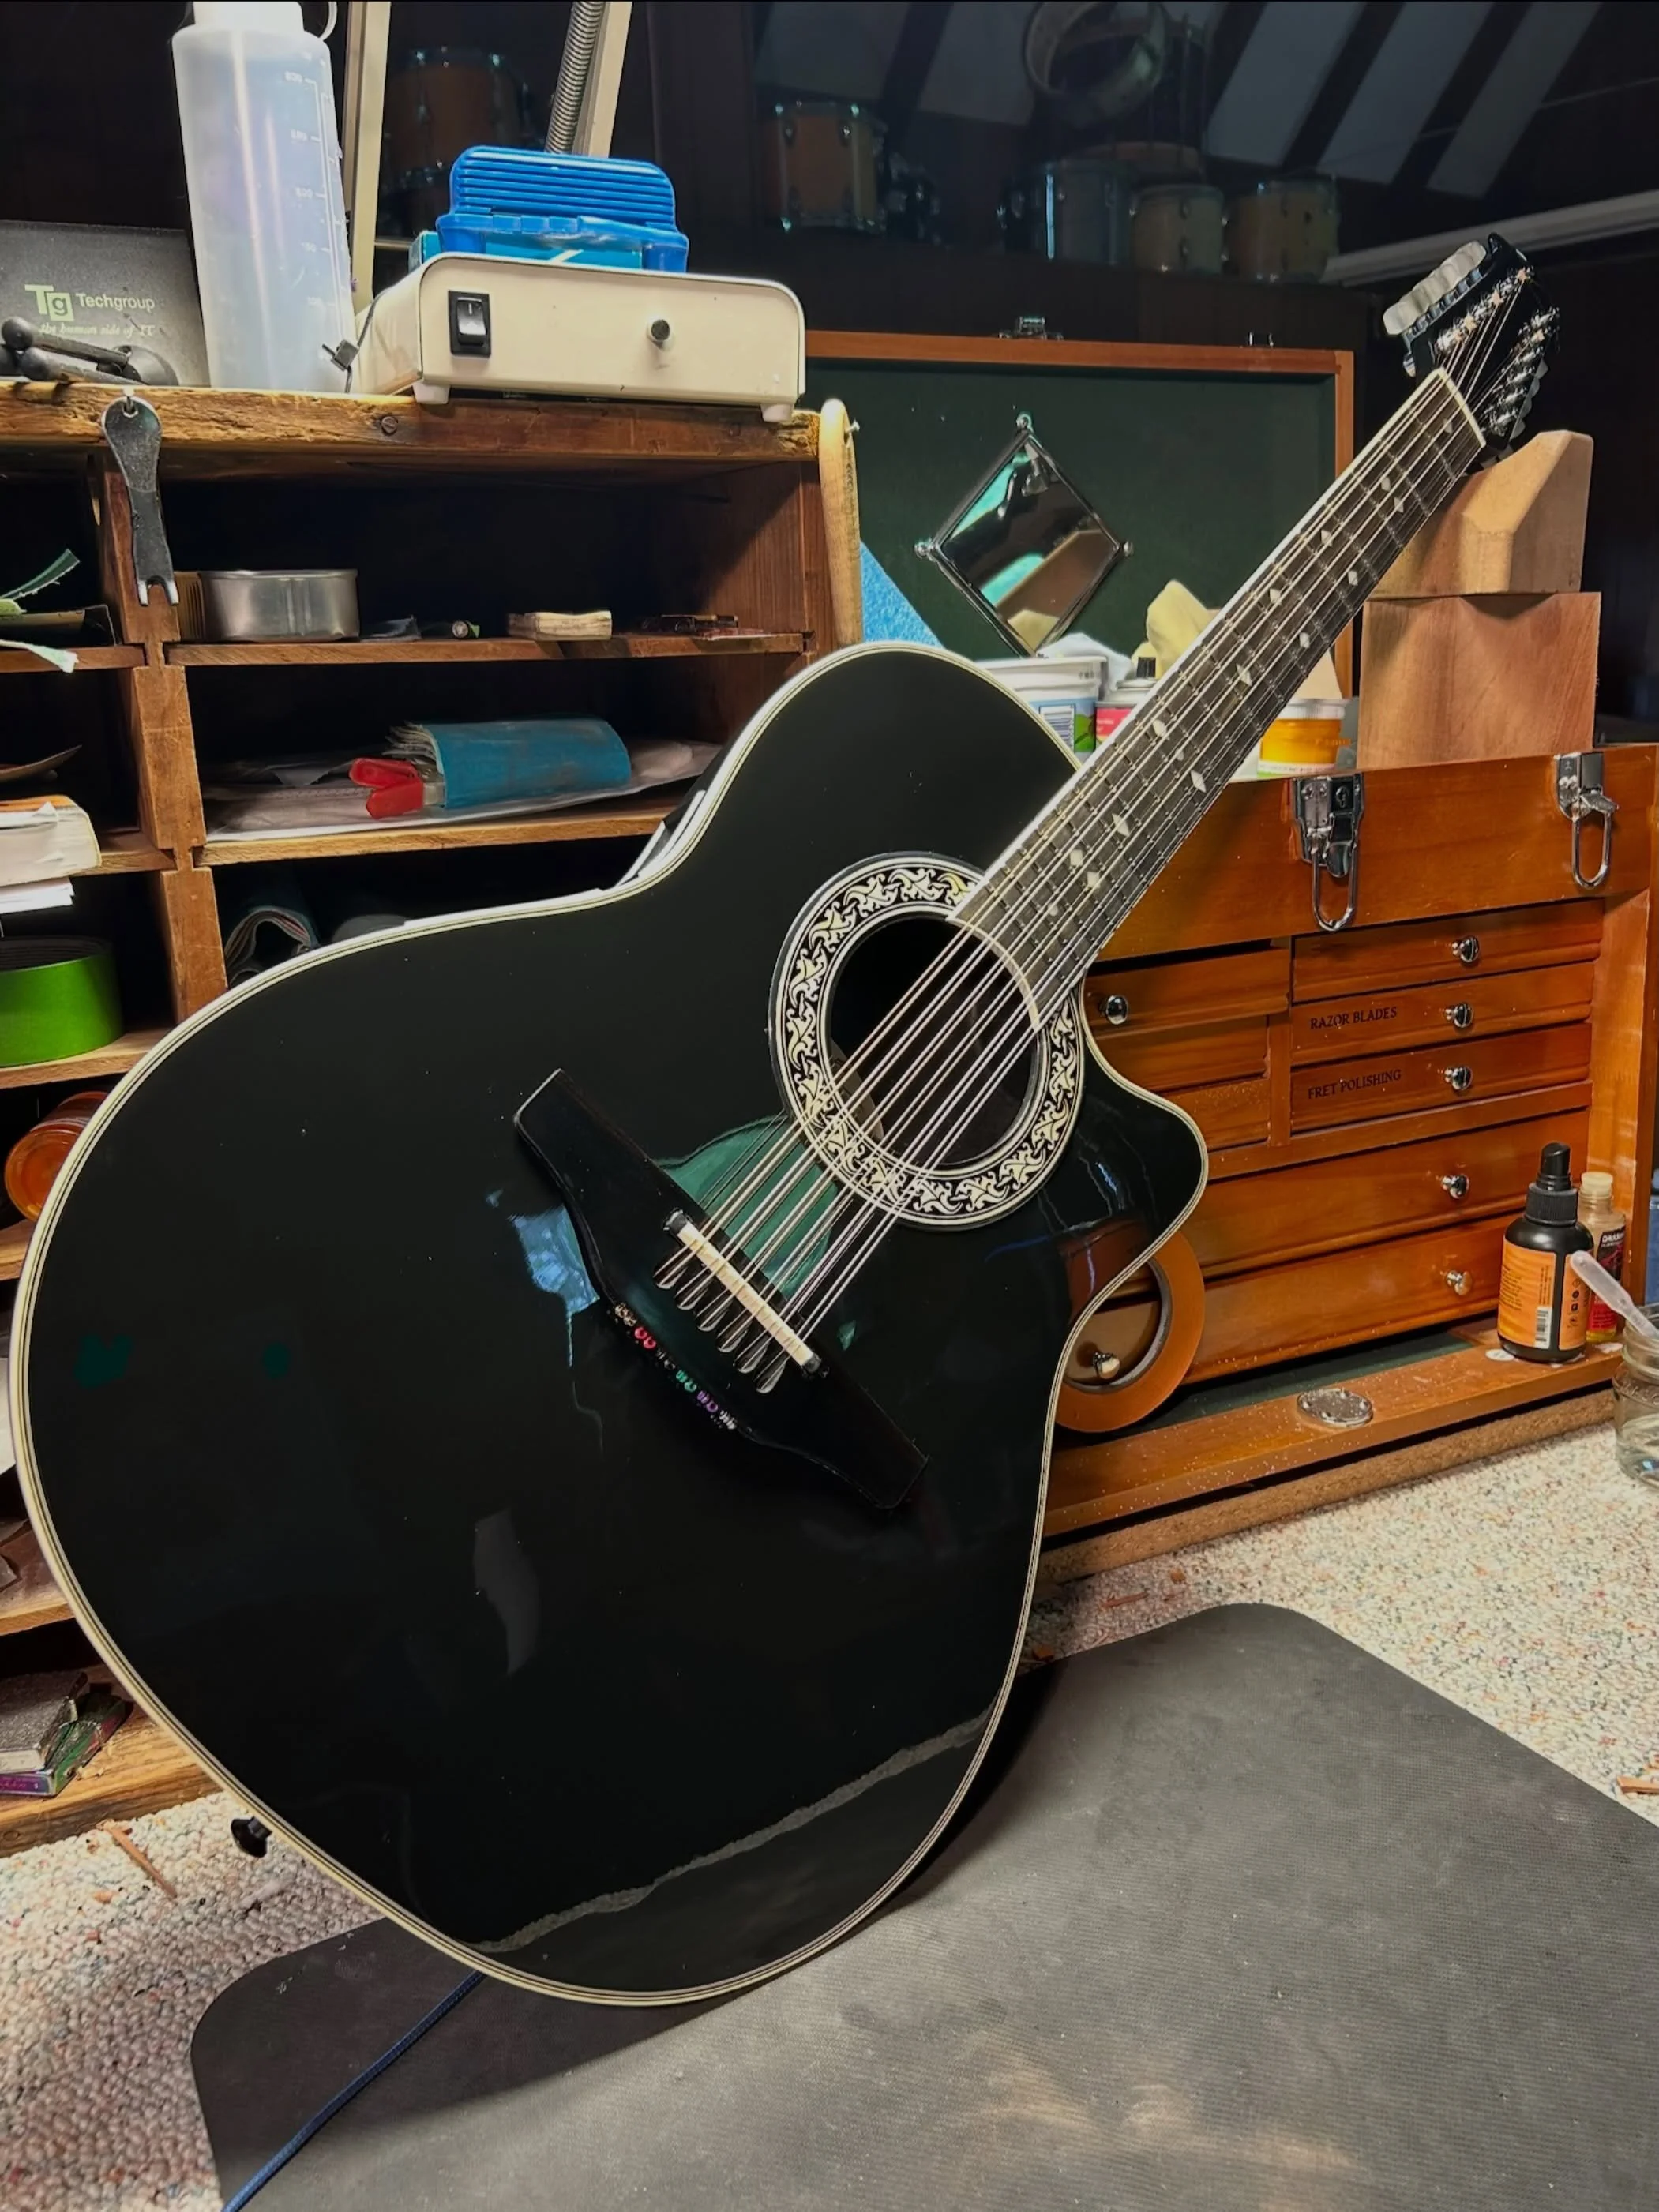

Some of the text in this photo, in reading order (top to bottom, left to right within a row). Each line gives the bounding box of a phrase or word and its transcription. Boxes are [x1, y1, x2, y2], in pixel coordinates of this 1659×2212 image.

[75, 292, 156, 312] Techgroup
[1310, 1007, 1397, 1029] RAZOR BLADES
[1308, 1069, 1402, 1100] FRET POLISHING
